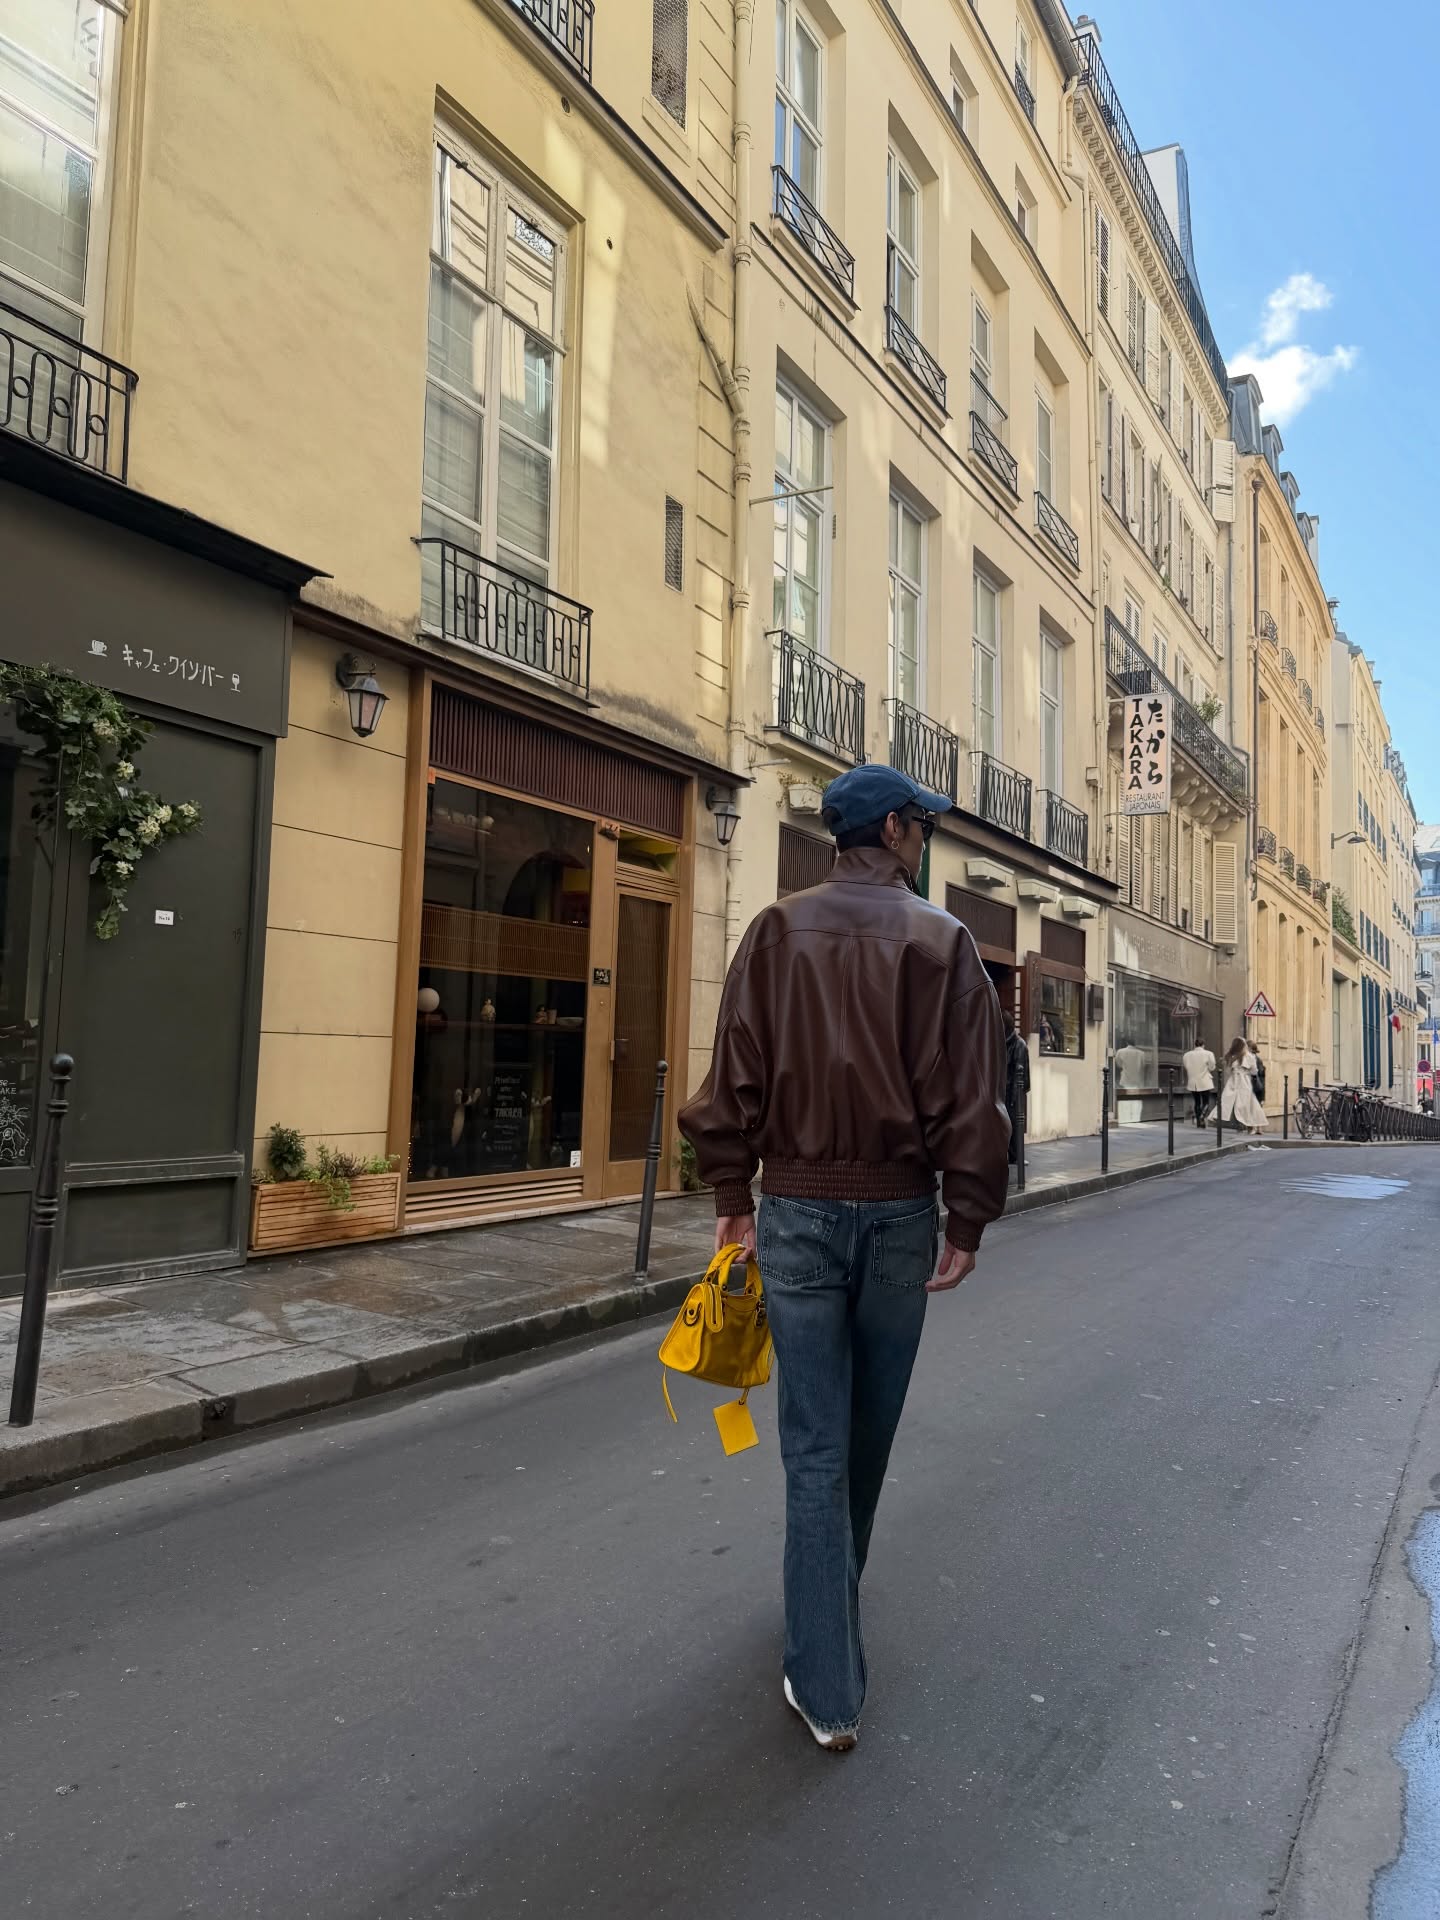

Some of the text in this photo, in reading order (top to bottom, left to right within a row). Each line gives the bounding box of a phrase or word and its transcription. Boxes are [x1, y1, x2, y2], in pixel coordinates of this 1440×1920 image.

[1128, 698, 1145, 790] TAKARA
[1146, 698, 1165, 785] たから
[1125, 792, 1165, 803] RESTAURANT
[1129, 800, 1161, 812] JAPONAIS
